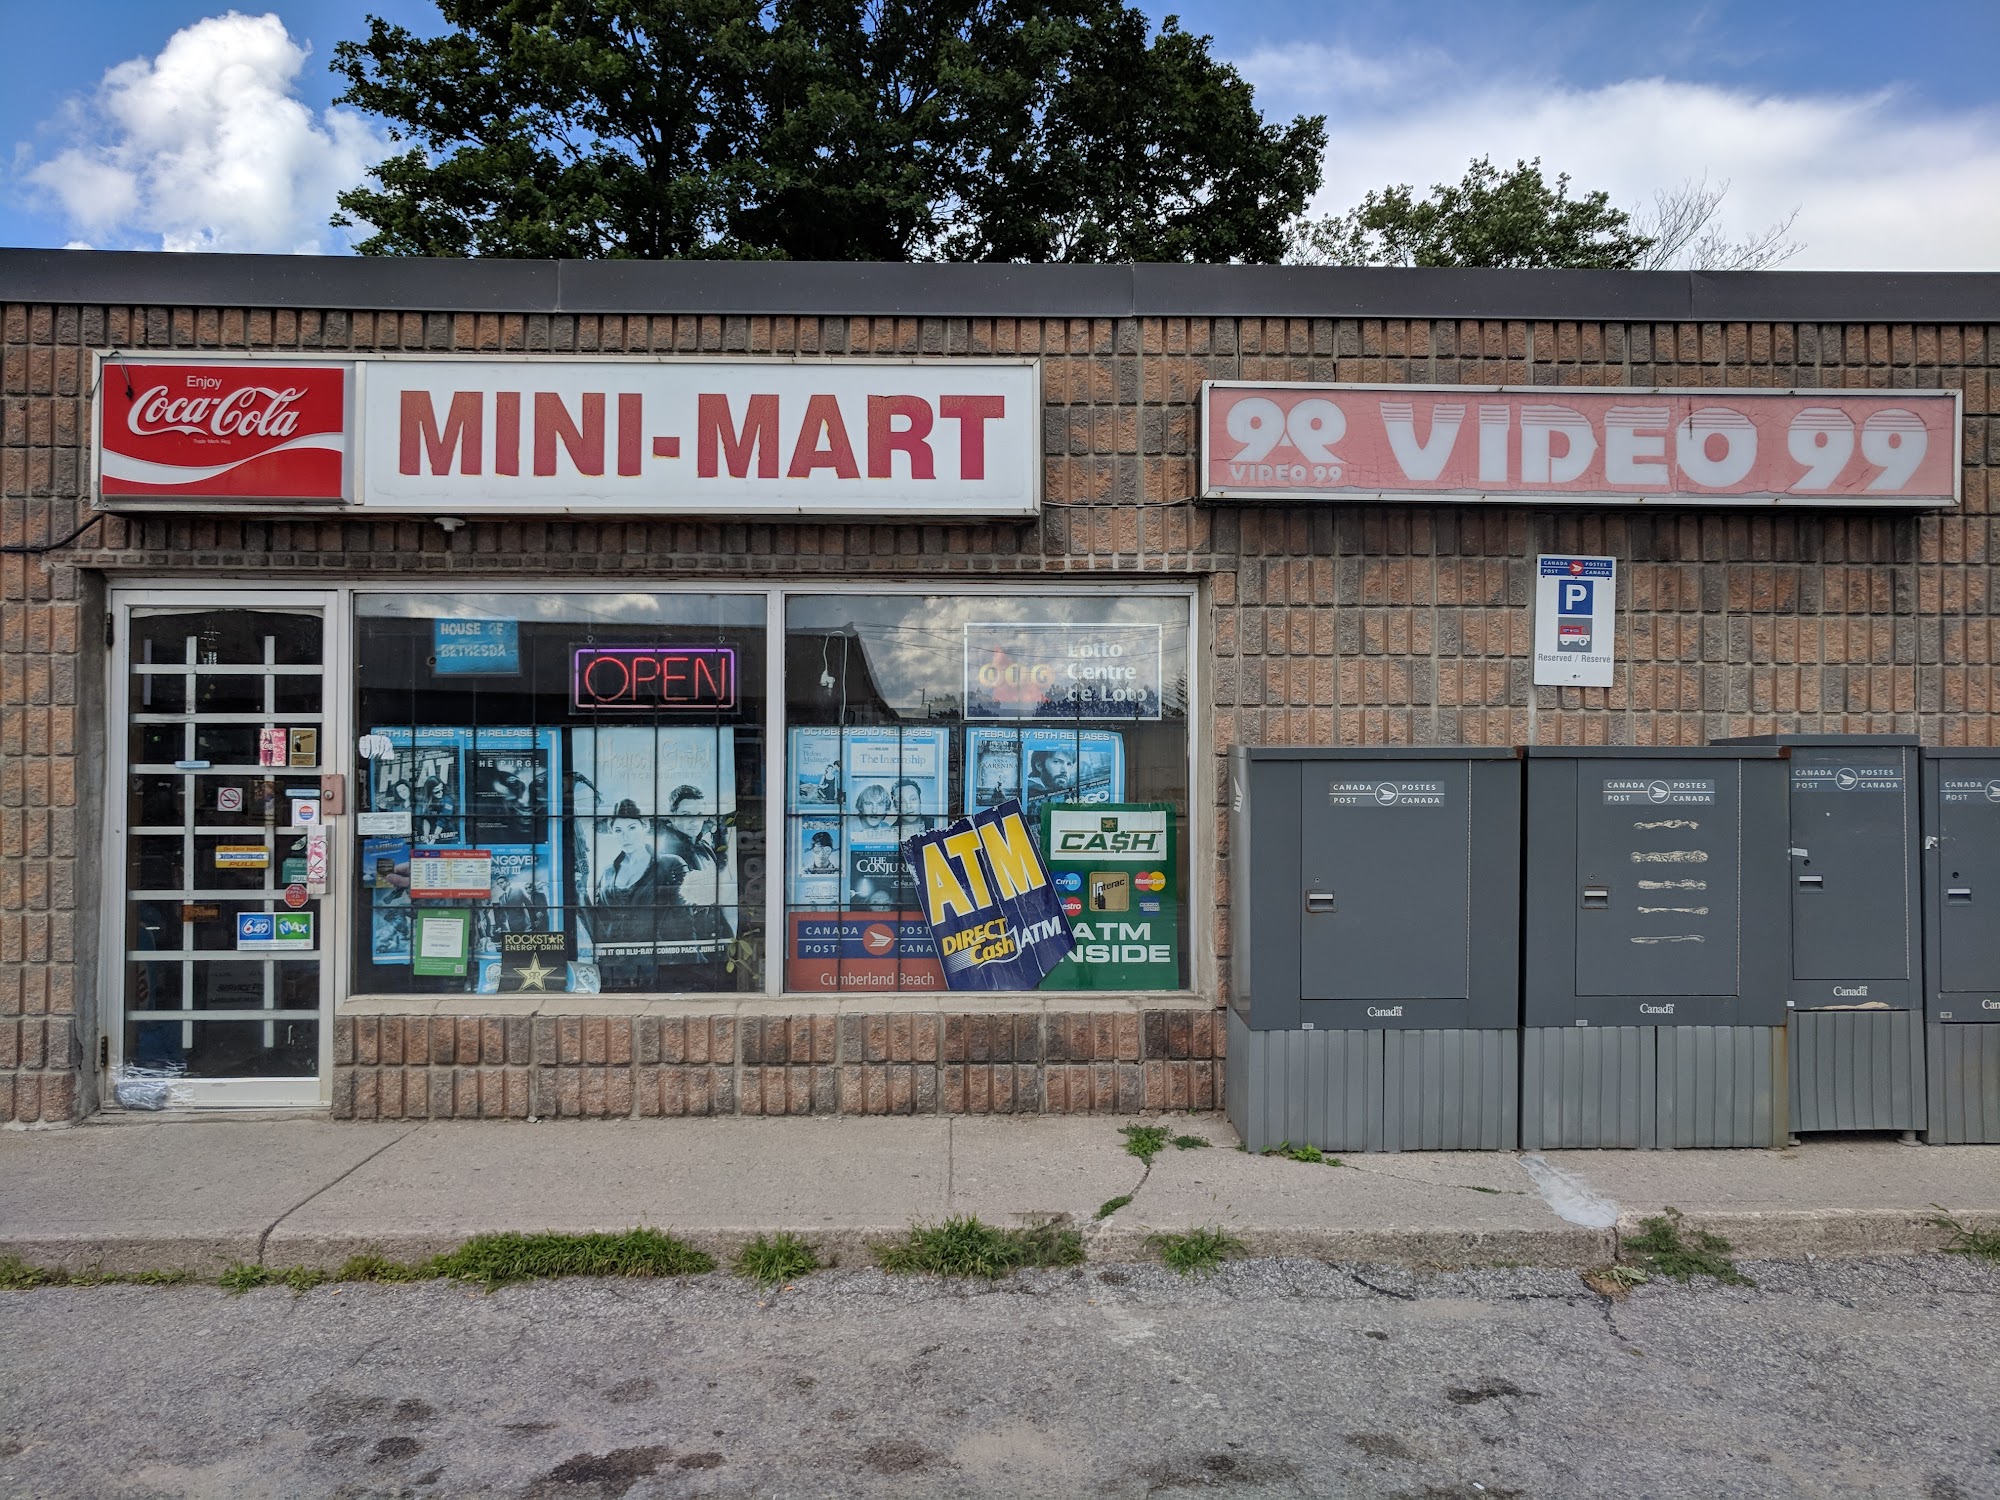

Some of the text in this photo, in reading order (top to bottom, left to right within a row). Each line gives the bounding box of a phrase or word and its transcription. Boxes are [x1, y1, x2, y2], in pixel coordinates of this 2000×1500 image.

[187, 376, 222, 390] Enjoy
[127, 385, 309, 437] Coca-Cola
[399, 390, 1005, 480] MINI-MART
[1380, 402, 1929, 490] VIDEO 99
[1230, 465, 1342, 482] VIDEO 99
[1566, 584, 1587, 610] P
[440, 623, 481, 635] HOUSE
[441, 644, 506, 657] BETHESDA
[1067, 643, 1123, 658] Lotto
[1538, 653, 1572, 662] Reserved
[1067, 663, 1137, 680] Centre
[585, 657, 726, 702] OPEN
[1067, 685, 1148, 702] de Loto
[850, 728, 880, 736] 22ND
[881, 729, 932, 737] RELEASES
[979, 731, 1110, 741] FEBRUARY 19TH RELEASES
[860, 754, 878, 764] The
[379, 756, 455, 792] HEAT
[869, 857, 887, 865] THE
[490, 866, 509, 874] PART
[922, 812, 1047, 926] ATM
[279, 920, 307, 935] MAX
[805, 926, 859, 935] CANADA
[900, 926, 931, 935] POST
[1021, 915, 1062, 950] ATM
[1073, 922, 1151, 941] ATM
[941, 918, 1007, 957] DIRECT
[626, 948, 654, 956] BLU-RAY
[699, 945, 716, 953] JUNE
[805, 944, 837, 953] POST
[900, 944, 934, 953] CANA
[1060, 944, 1171, 963] NSIDE
[820, 972, 935, 986] Cumberland Beach
[1833, 985, 1868, 997] Canada
[1367, 1005, 1403, 1017] Canada
[1639, 1003, 1675, 1014] Canada
[1981, 999, 2000, 1010] Can
